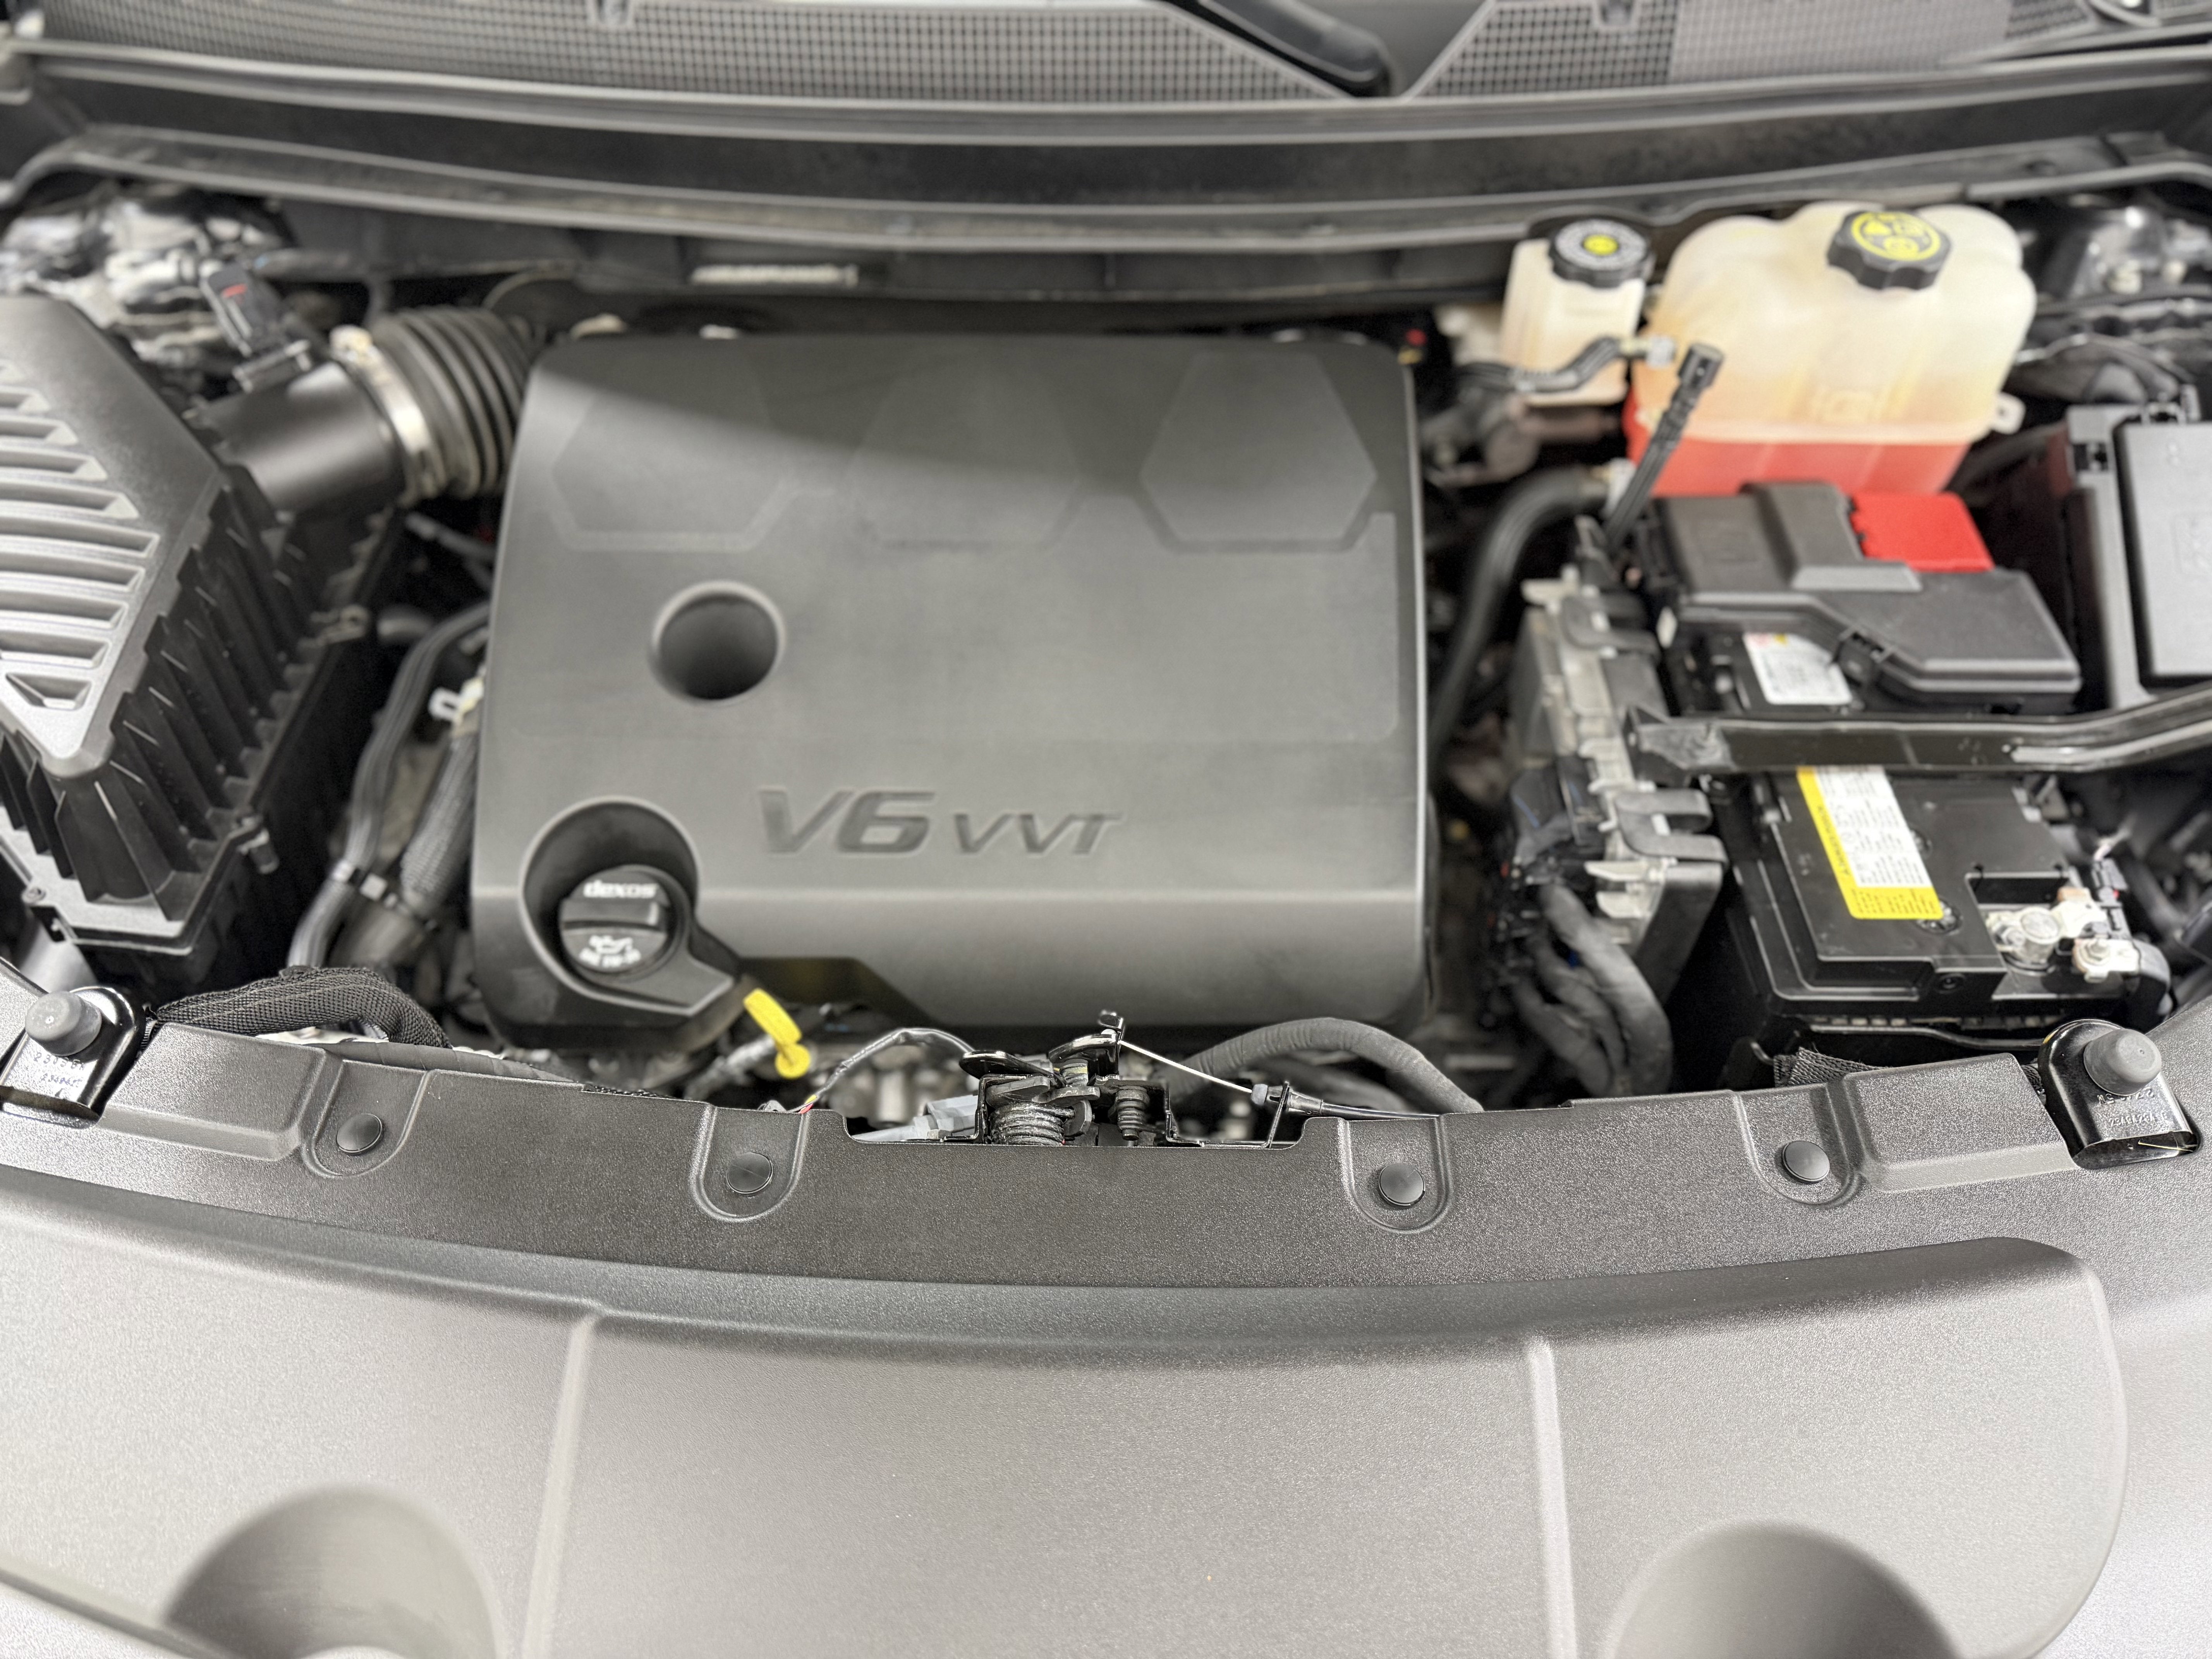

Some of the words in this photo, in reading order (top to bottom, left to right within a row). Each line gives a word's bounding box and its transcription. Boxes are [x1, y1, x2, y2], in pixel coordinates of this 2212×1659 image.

[758, 789, 935, 854] V6
[953, 812, 1123, 854] VVT
[583, 879, 658, 899] dexos
